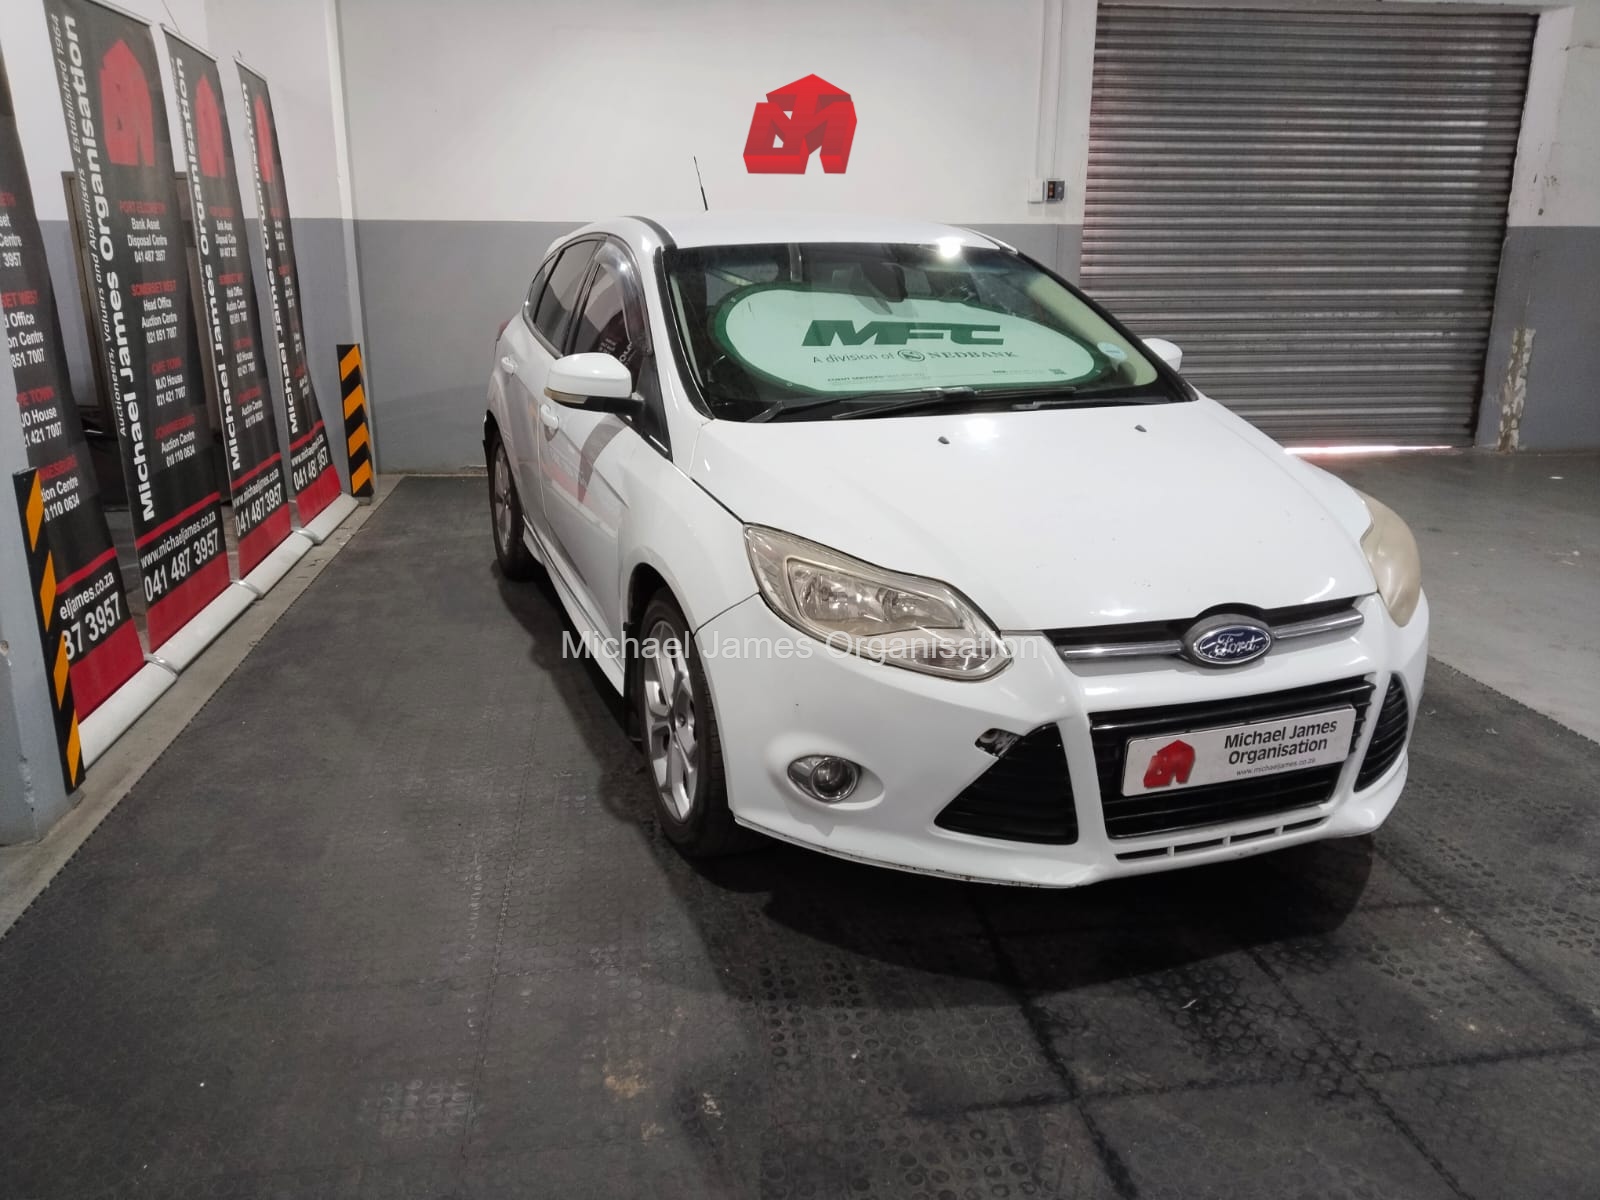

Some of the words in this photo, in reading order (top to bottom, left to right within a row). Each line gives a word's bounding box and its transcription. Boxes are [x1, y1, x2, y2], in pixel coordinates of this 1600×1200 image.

[58, 59, 82, 154] Established
[64, 15, 113, 261] Organisation
[176, 57, 209, 256] Organisation
[78, 167, 97, 250] Appraisers
[91, 252, 102, 284] and
[143, 298, 157, 311] Head
[157, 297, 172, 309] Office
[205, 264, 224, 356] James
[267, 257, 283, 336] James
[10, 311, 35, 327] Office
[98, 287, 111, 342] Valuers
[107, 271, 133, 383] James
[141, 315, 161, 328] Auction
[162, 312, 177, 325] Centre
[19, 331, 44, 346] Centre
[802, 319, 1004, 347] MFC
[27, 348, 45, 365] 7007
[813, 354, 823, 364] A
[826, 353, 878, 363] division
[881, 351, 895, 361] of
[928, 351, 1019, 359] NEDBANK
[167, 374, 183, 387] House
[279, 342, 299, 434] Michael
[31, 407, 57, 424] House
[218, 362, 241, 471] Michael
[31, 428, 45, 444] 421
[45, 421, 62, 439] 7007
[161, 437, 180, 455] Auction
[123, 392, 155, 522] Michael
[56, 477, 79, 495] Centre
[293, 466, 308, 491] 041
[49, 501, 64, 518] 110
[64, 492, 80, 512] 0634
[235, 507, 251, 537] 041
[251, 496, 265, 522] 487
[264, 482, 282, 512] 3957
[140, 511, 216, 569] www.michaeljames.co.za
[144, 564, 168, 602] 041
[171, 546, 190, 581] 487
[193, 527, 218, 565] 3957
[60, 571, 115, 620] eljames.co.za
[85, 591, 121, 642] 3957
[1212, 632, 1261, 657] Ford
[1224, 726, 1286, 749] Michael
[1289, 720, 1338, 740] James
[1229, 738, 1328, 765] Organisation
